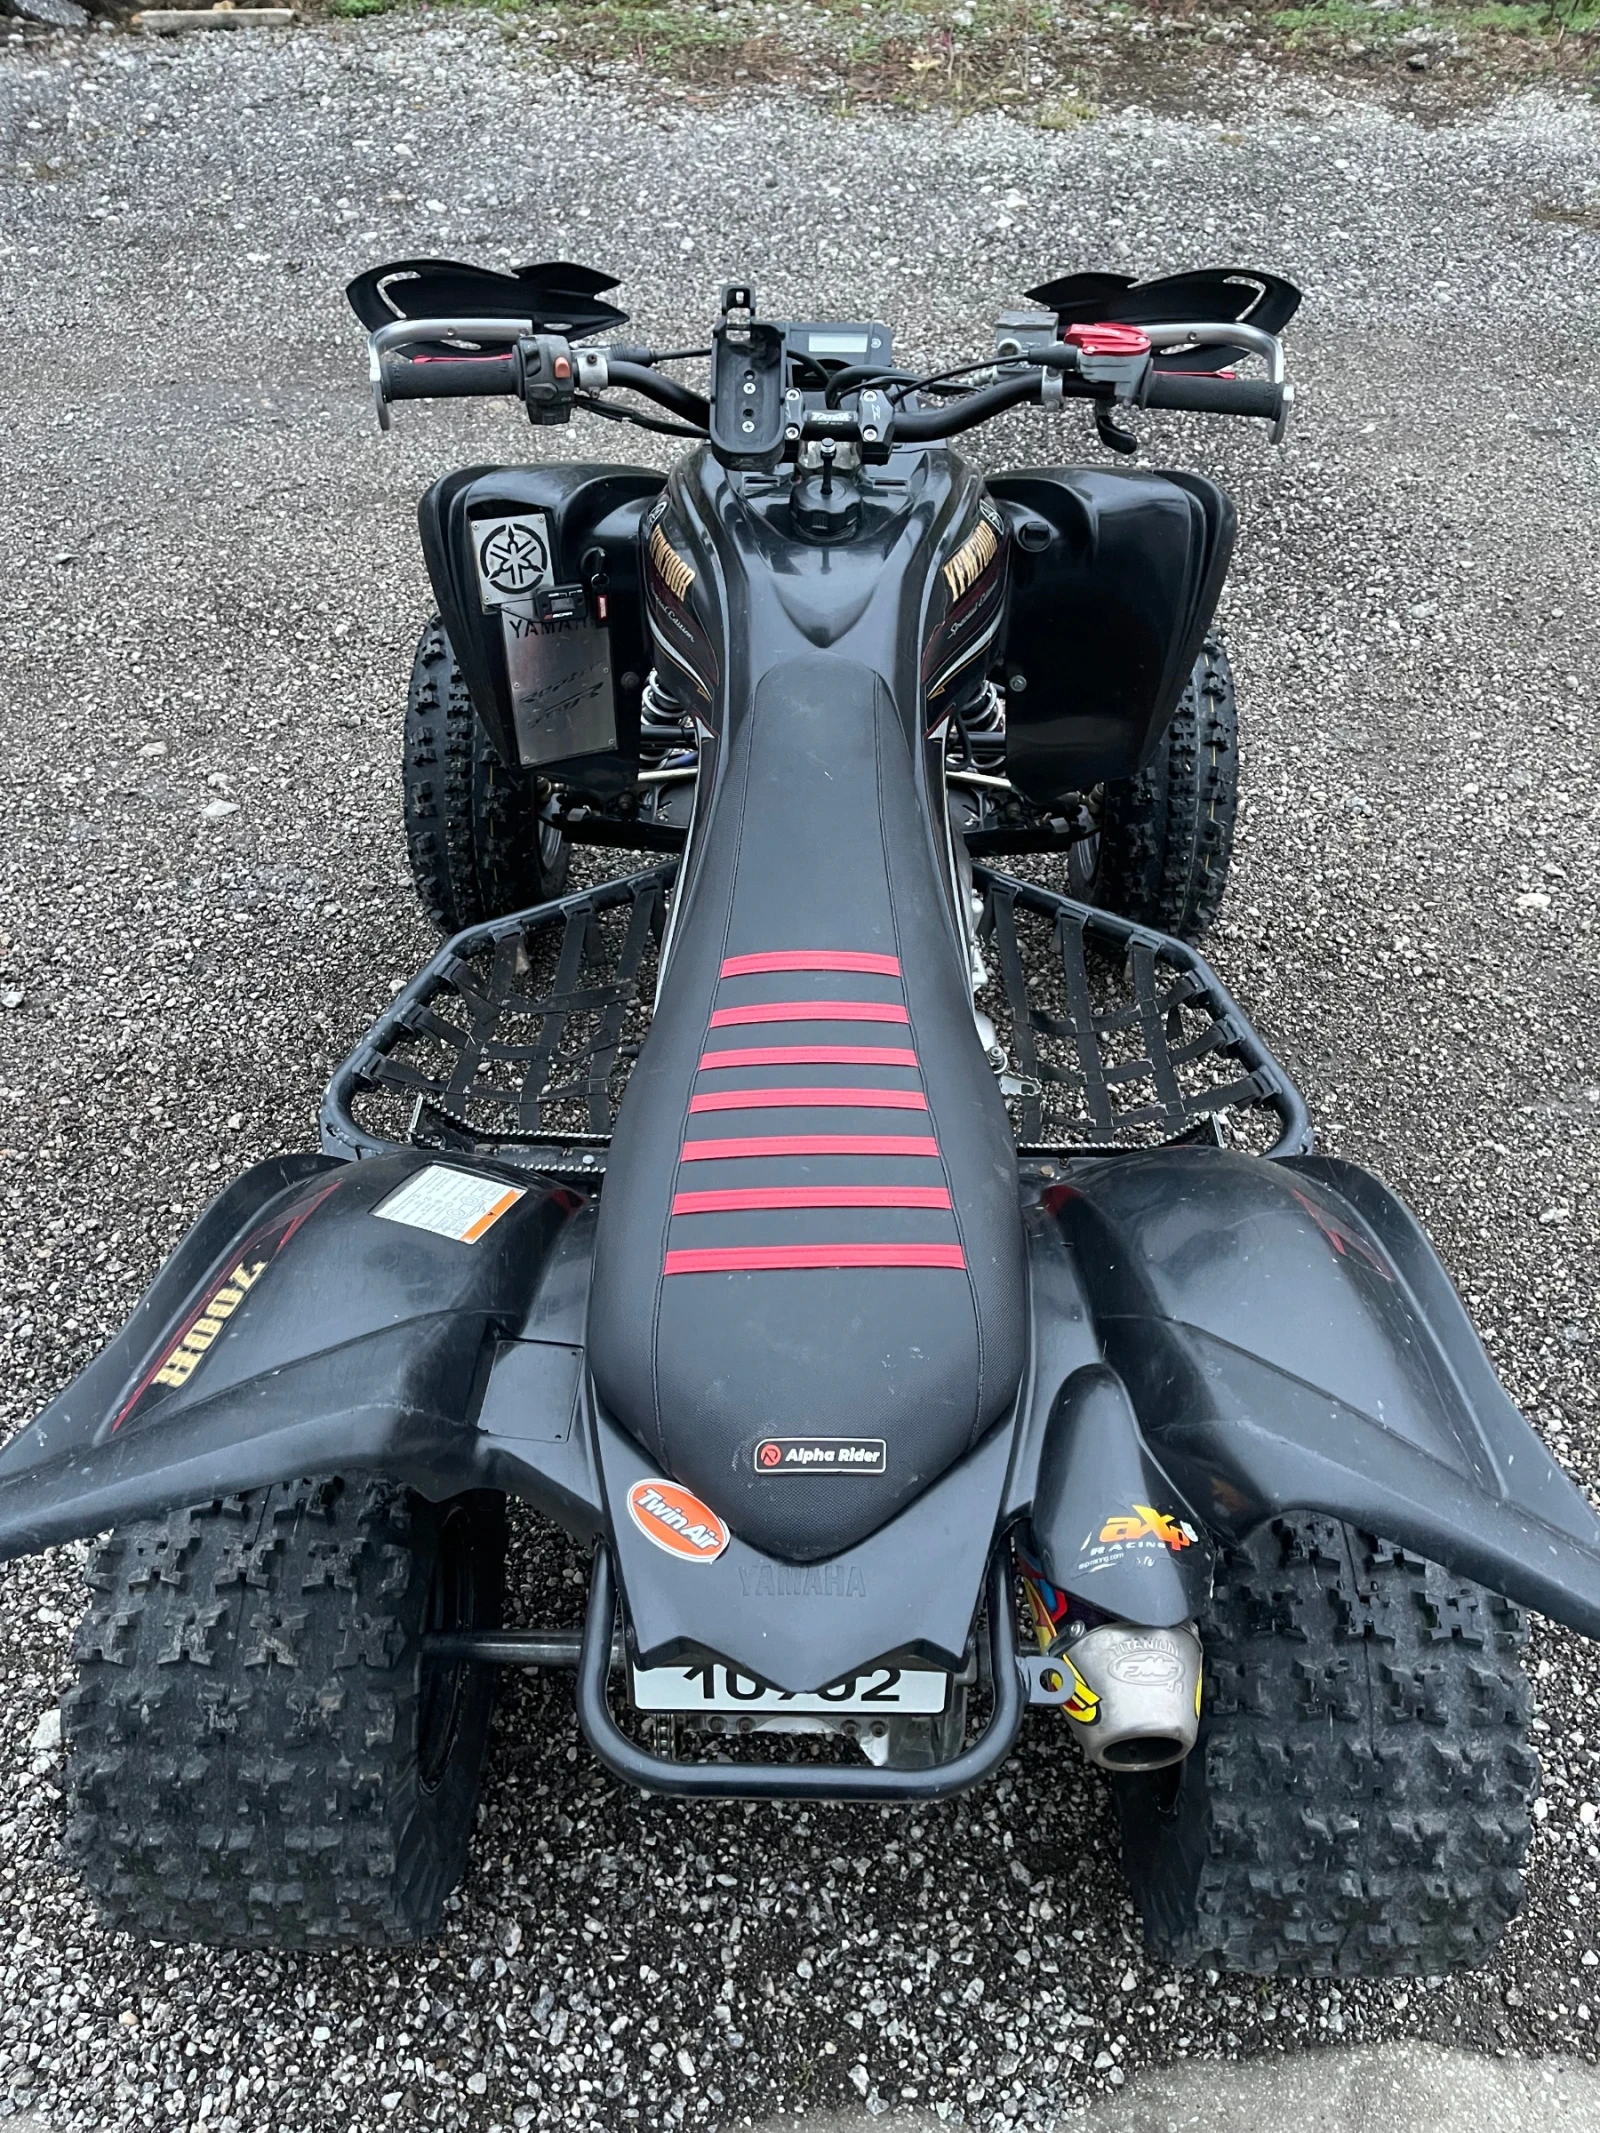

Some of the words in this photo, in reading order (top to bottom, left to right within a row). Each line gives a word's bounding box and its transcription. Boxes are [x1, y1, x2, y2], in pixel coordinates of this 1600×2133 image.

[150, 1260, 269, 1388] 700R
[785, 1448, 836, 1465] Alpha
[838, 1447, 880, 1463] Rider
[636, 1487, 689, 1531] Twin
[680, 1524, 721, 1550] Air
[738, 1565, 867, 1598] YAMAHA
[1110, 1637, 1180, 1658] TITANIUM
